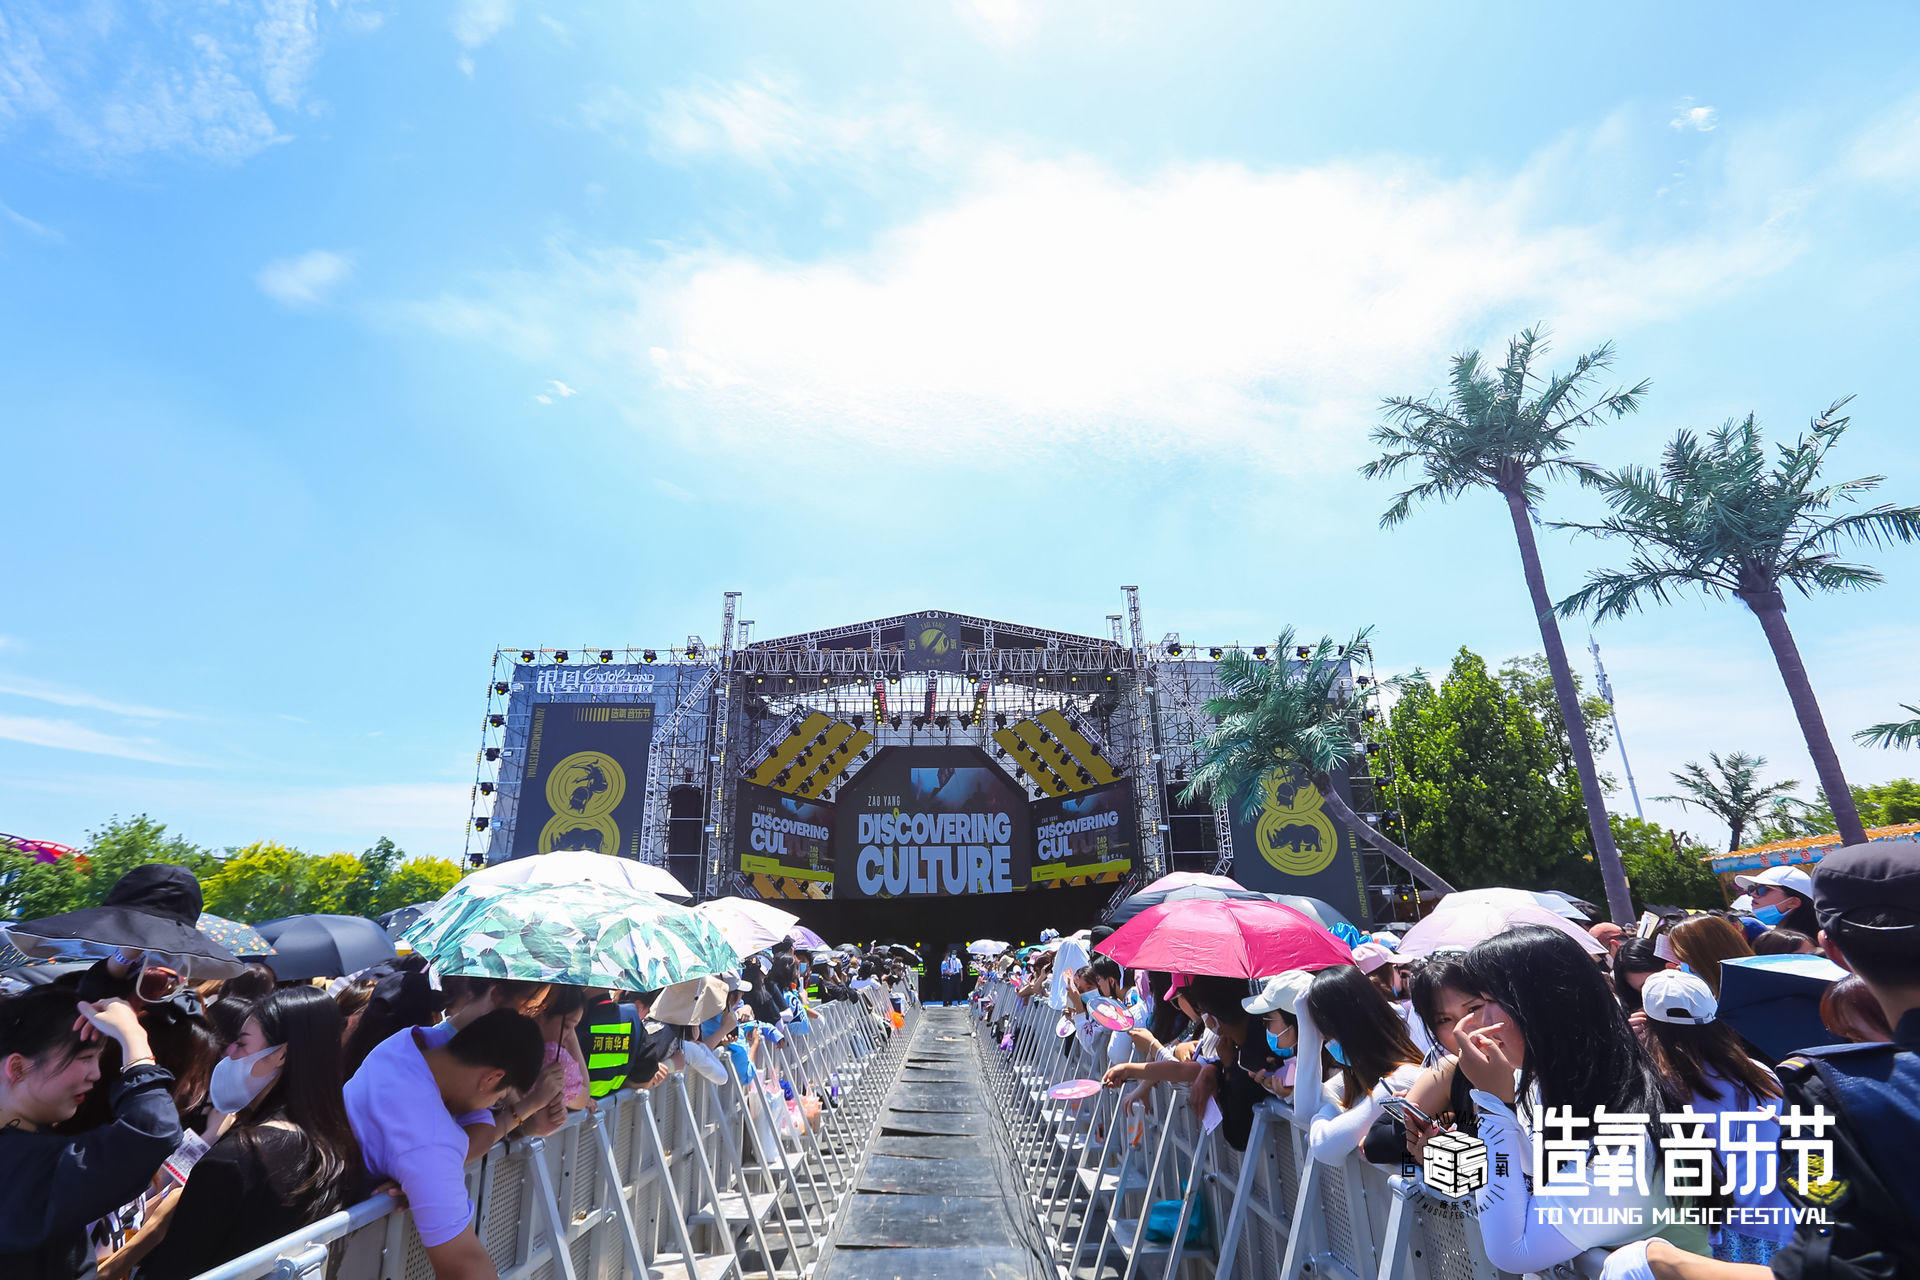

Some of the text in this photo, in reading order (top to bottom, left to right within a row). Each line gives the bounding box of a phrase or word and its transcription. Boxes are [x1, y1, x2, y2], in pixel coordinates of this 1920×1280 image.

[868, 796, 900, 807] ZAO YANG
[751, 812, 829, 840] DISCOVERING
[858, 812, 1012, 844] DISCOVERING
[1037, 810, 1119, 840] DISCOVERING
[856, 844, 1013, 895] CULTURE
